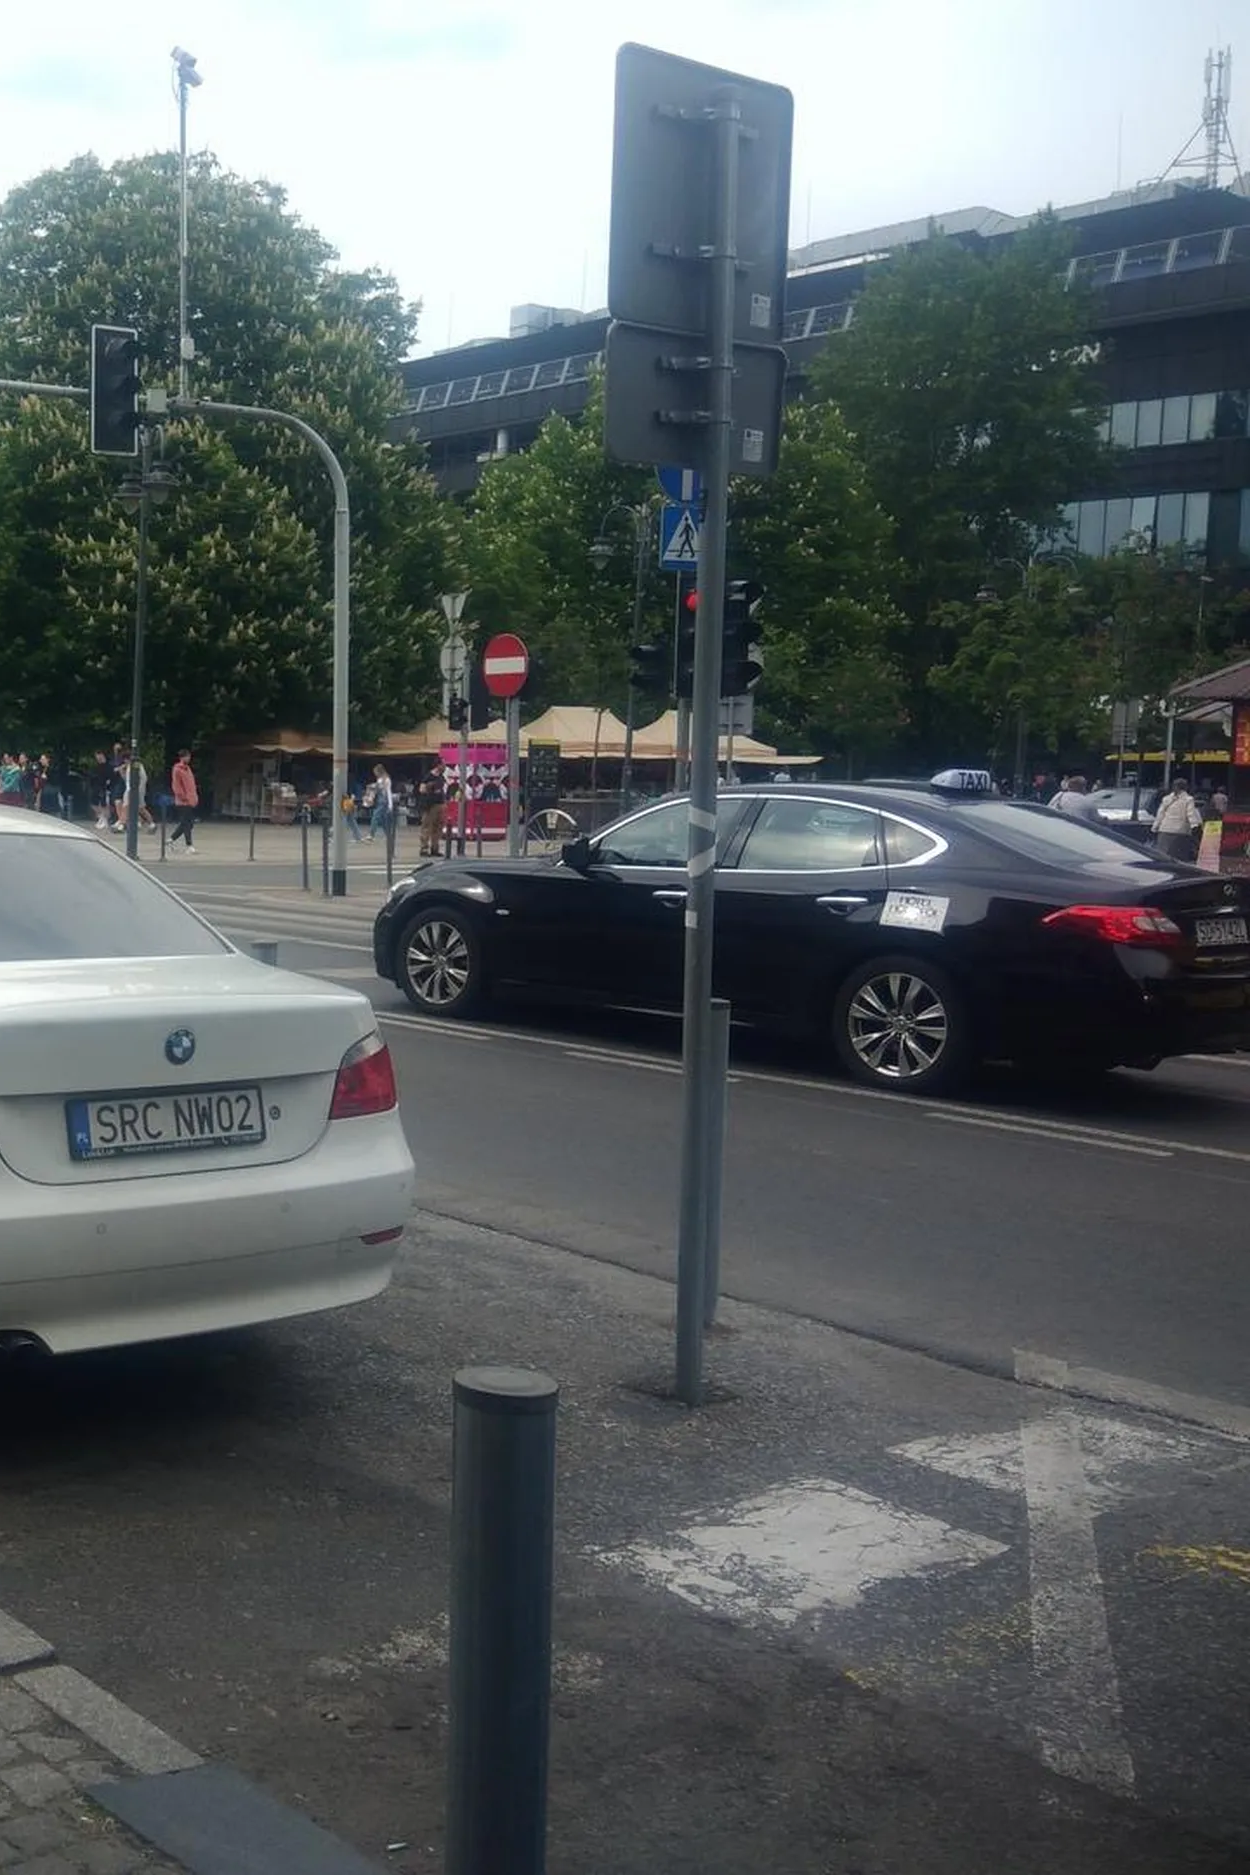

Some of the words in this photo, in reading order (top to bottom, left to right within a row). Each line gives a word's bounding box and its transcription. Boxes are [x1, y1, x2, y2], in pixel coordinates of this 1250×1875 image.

[958, 772, 988, 791] TAXI
[96, 1101, 163, 1144] SRC
[174, 1095, 253, 1137] NW02
